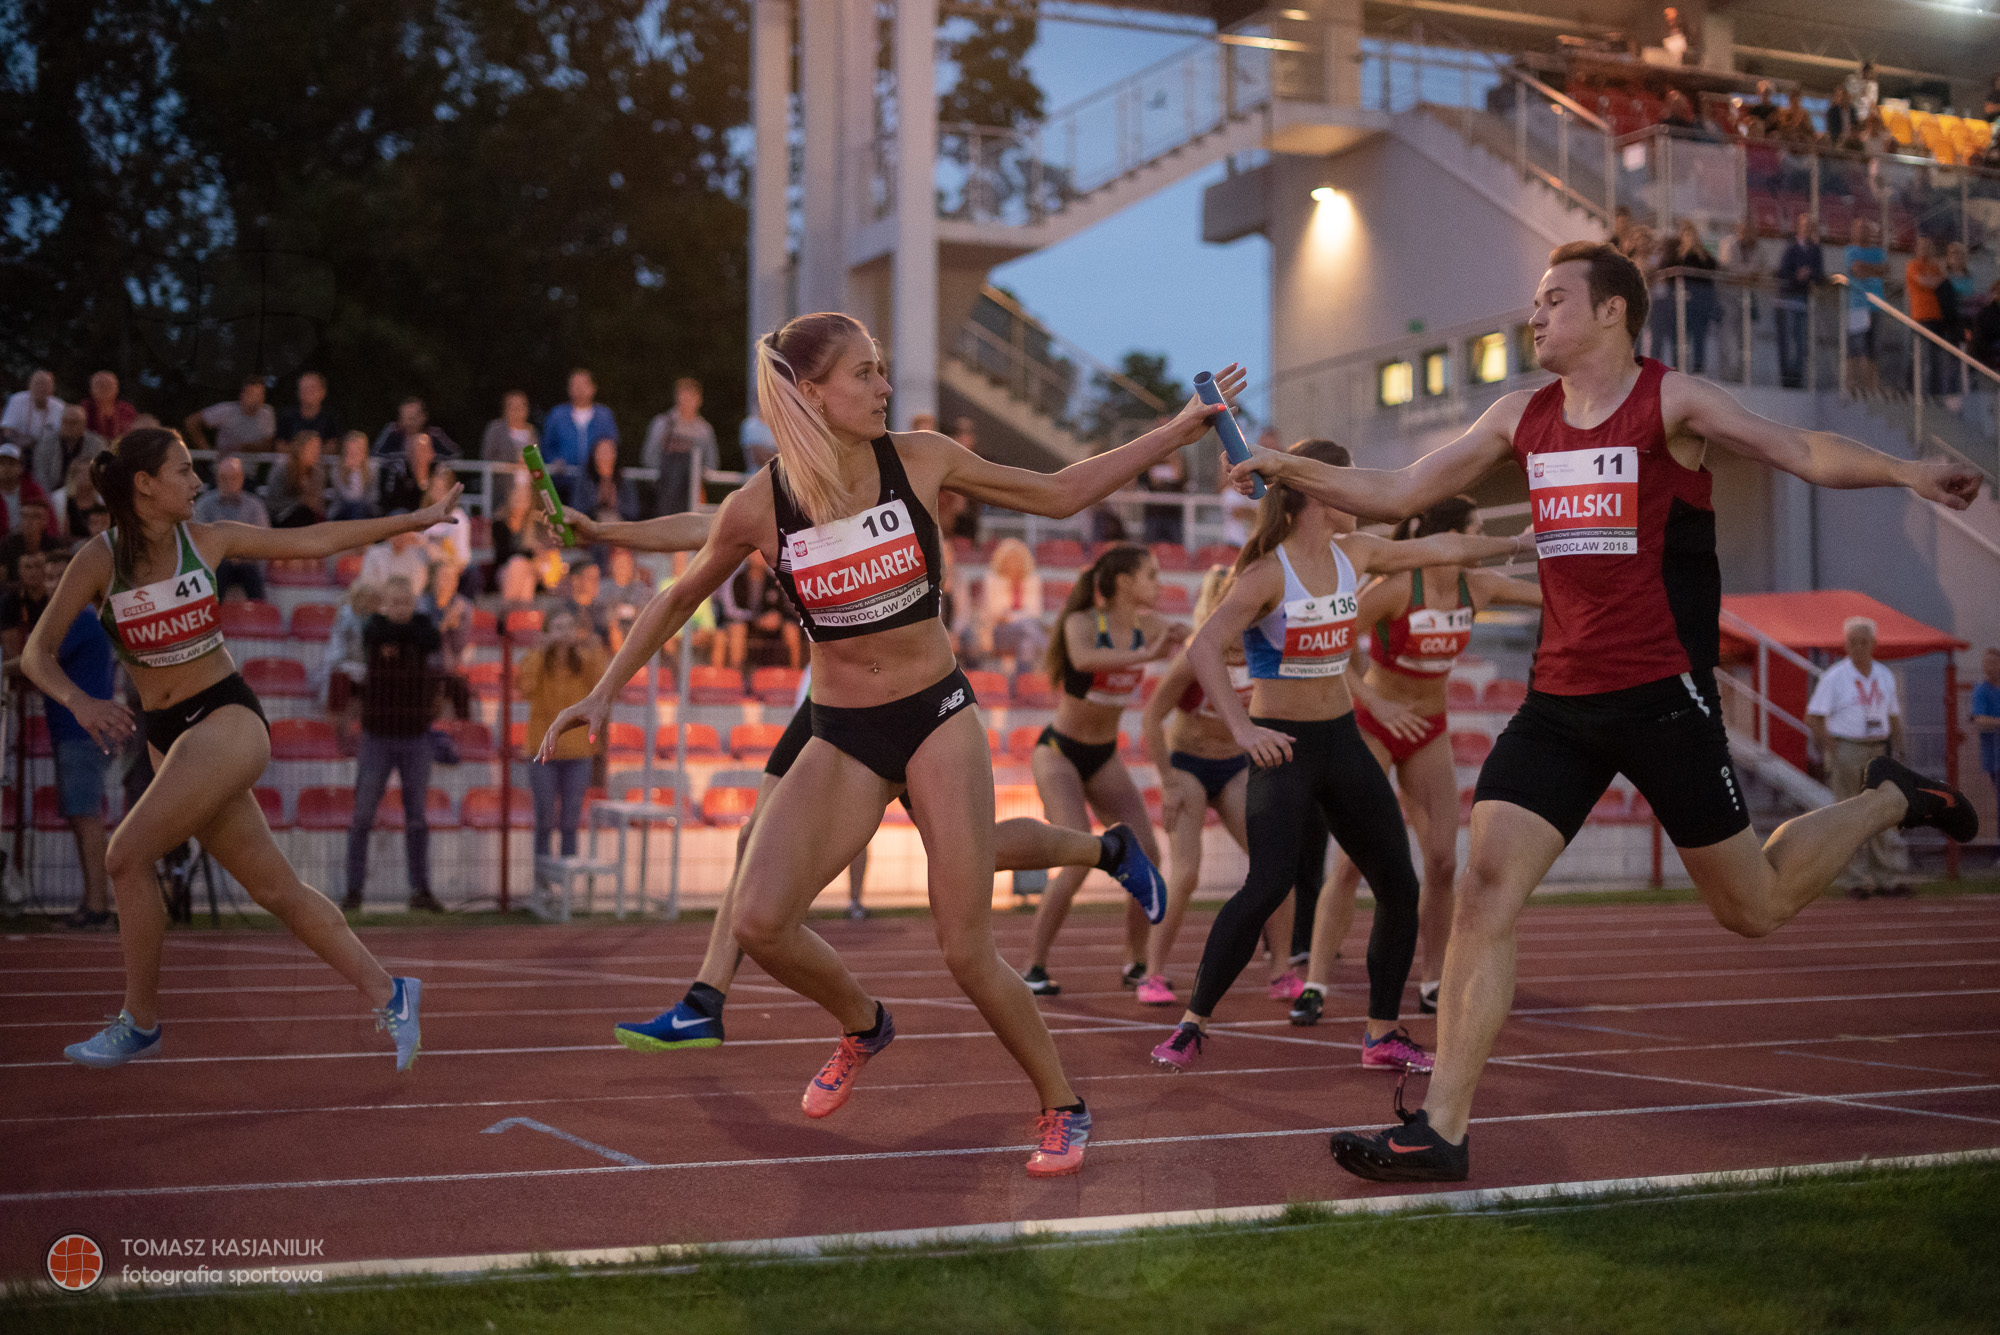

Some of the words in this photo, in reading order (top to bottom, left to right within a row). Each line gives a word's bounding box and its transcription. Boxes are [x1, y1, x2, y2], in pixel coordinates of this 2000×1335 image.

[1593, 453, 1623, 476] 11
[1538, 493, 1622, 522] MALSKI
[862, 509, 900, 538] 10
[1602, 541, 1629, 552] 2018
[800, 545, 921, 602] KACZMAREK
[175, 576, 202, 598] 41
[124, 602, 153, 616] ORLEN
[820, 601, 899, 624] INOWROCŁAW
[901, 587, 922, 607] 2018
[1329, 596, 1357, 616] 136
[126, 604, 214, 645] IWANEK
[1297, 627, 1350, 652] DALKE
